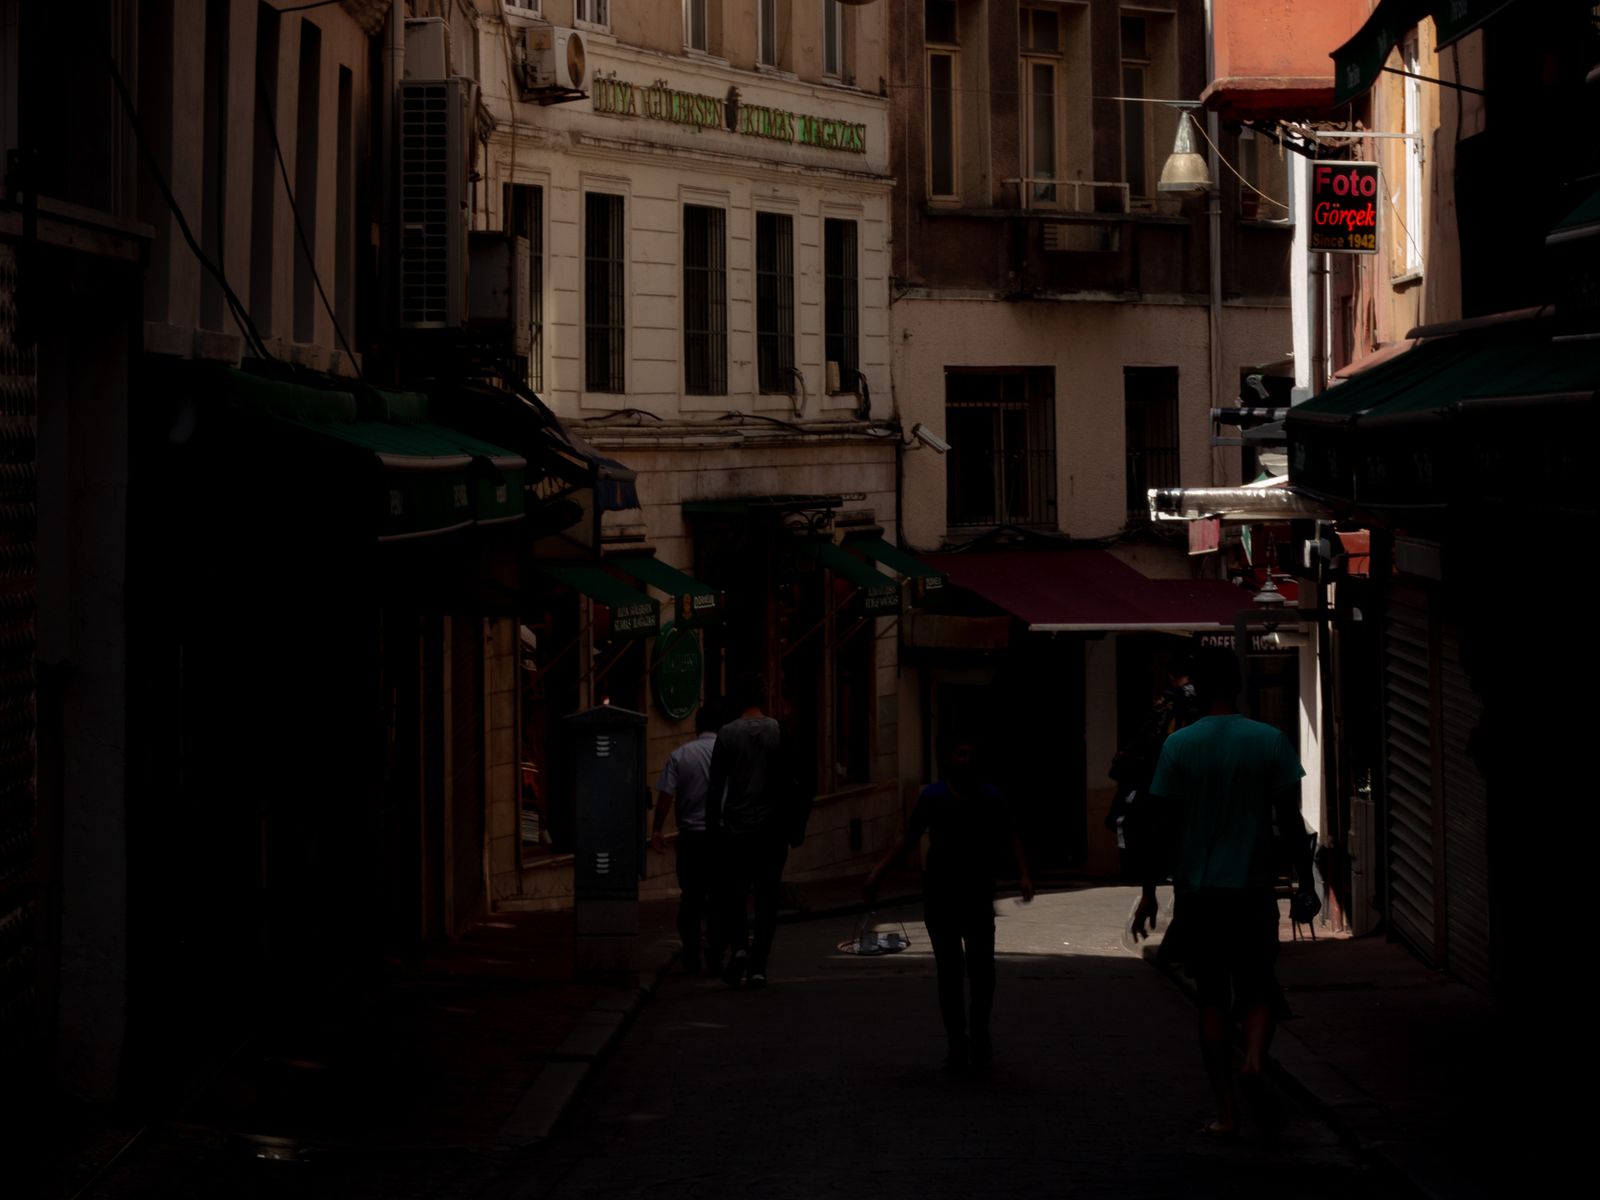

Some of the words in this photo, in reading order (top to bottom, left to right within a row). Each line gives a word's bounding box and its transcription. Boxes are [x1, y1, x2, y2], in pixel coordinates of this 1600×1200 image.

[1316, 167, 1376, 196] Foto
[1315, 202, 1375, 231] Görçek
[1312, 234, 1344, 247] Since
[1348, 234, 1376, 248] 1942
